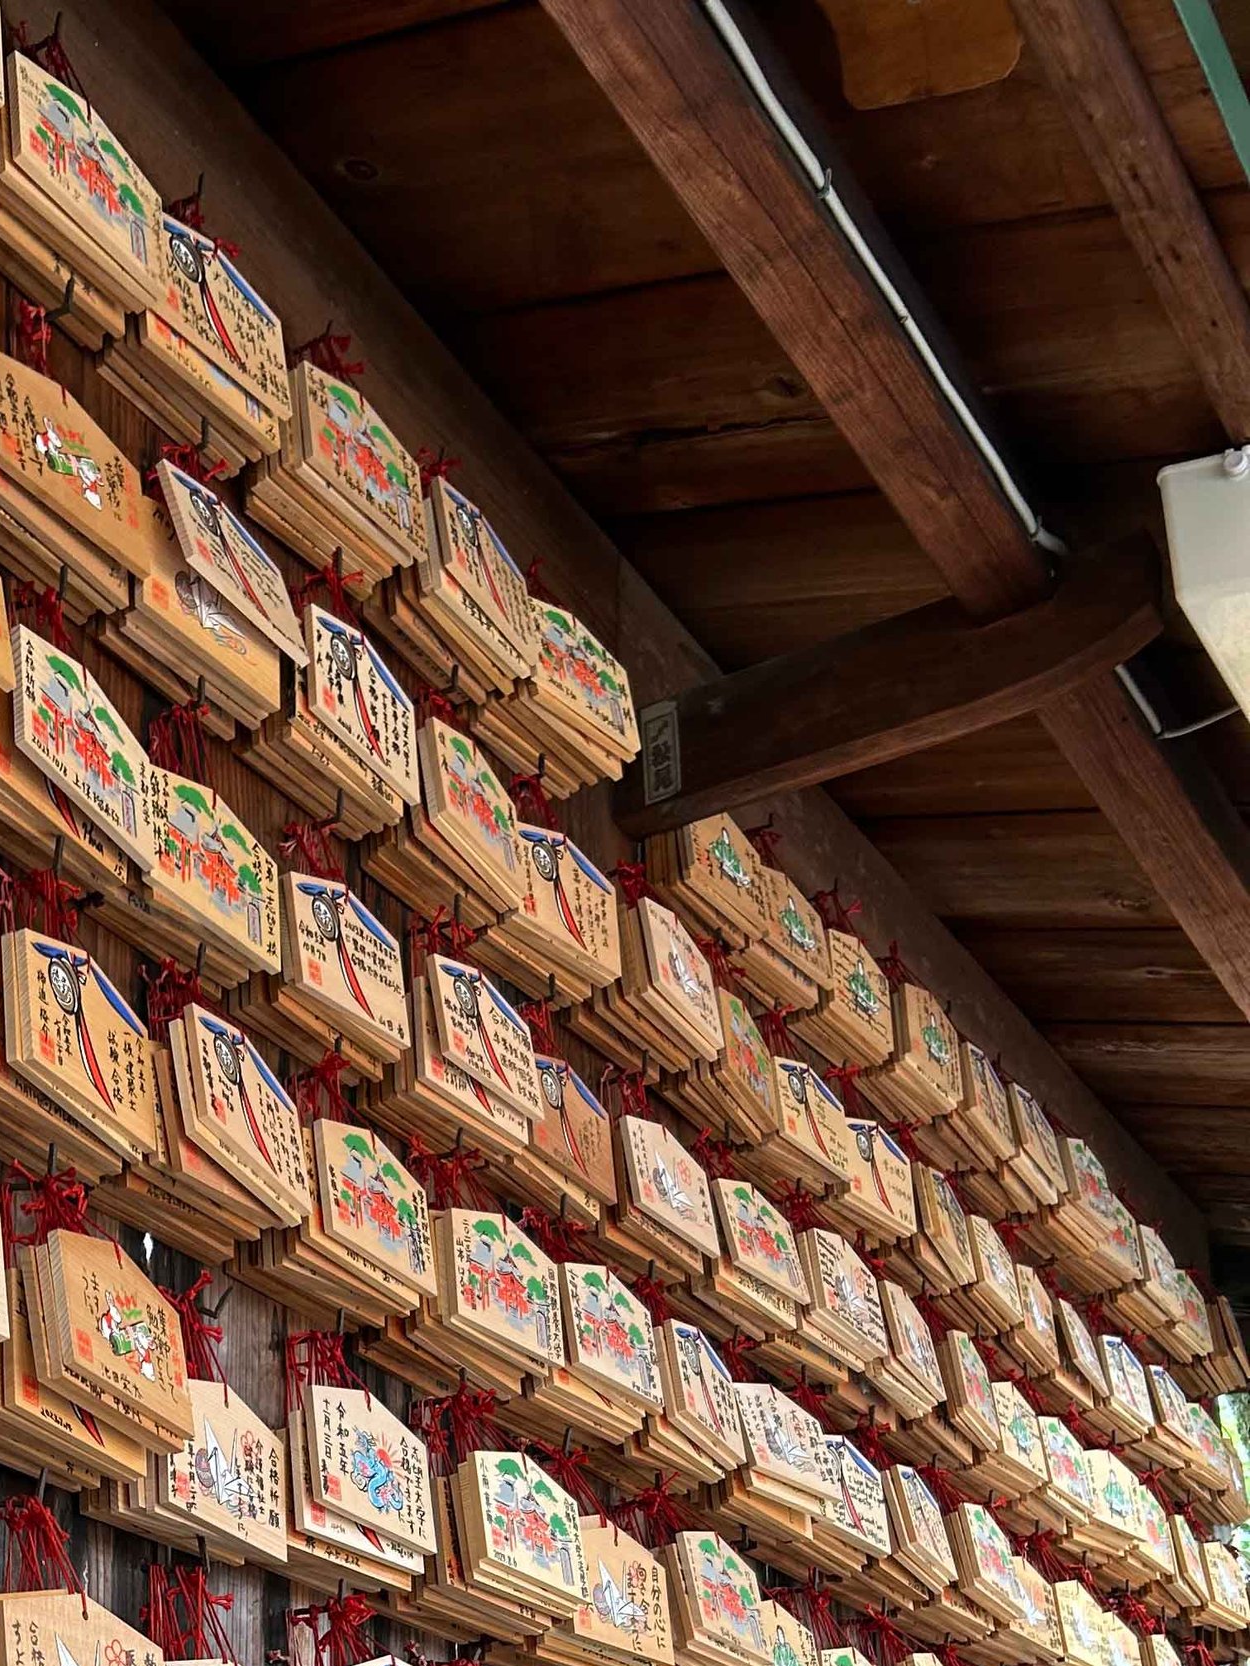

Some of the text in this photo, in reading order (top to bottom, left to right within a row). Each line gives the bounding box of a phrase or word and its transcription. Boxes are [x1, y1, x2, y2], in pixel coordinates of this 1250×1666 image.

[336, 1401, 350, 1477] 令和五年
[268, 1447, 282, 1530] 合格祈願
